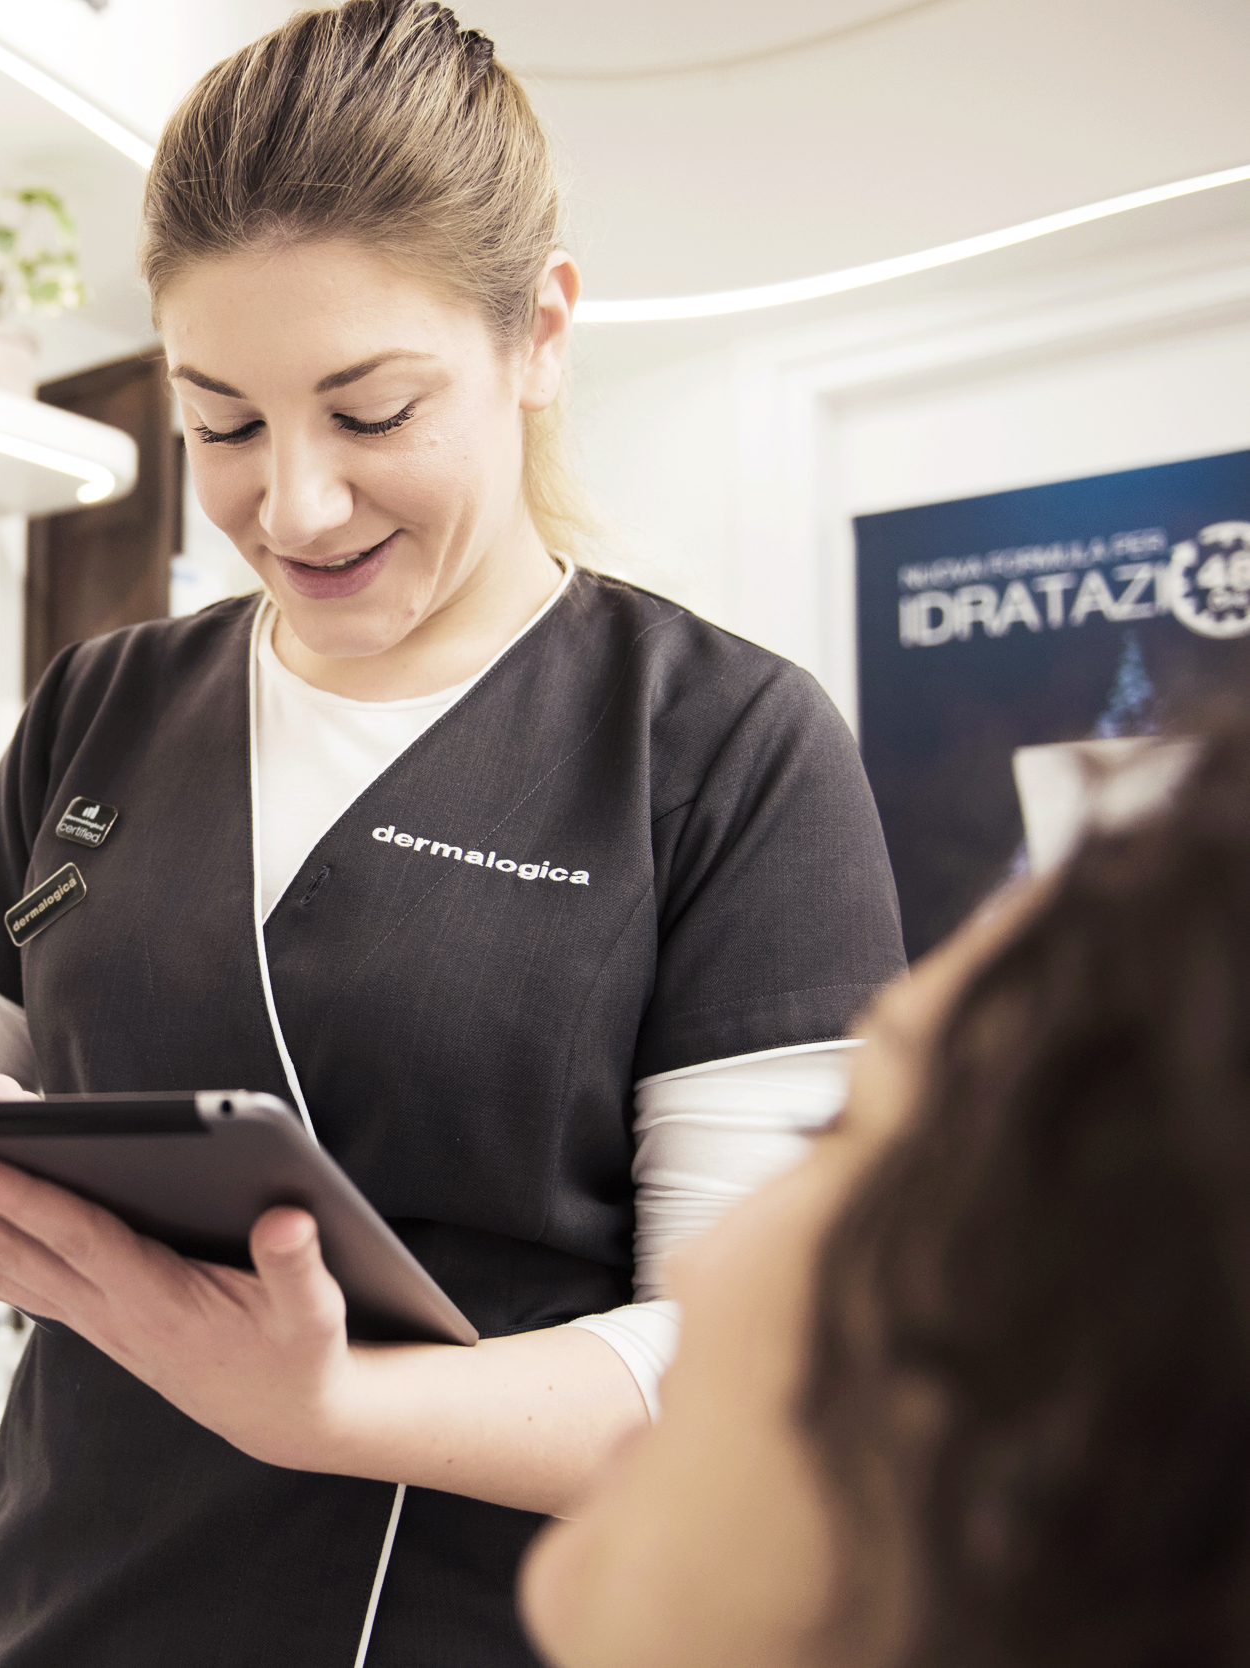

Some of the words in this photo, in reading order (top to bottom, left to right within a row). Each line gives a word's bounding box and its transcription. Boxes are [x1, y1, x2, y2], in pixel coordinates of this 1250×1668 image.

[59, 822, 101, 843] certified
[372, 825, 590, 886] dermalogica
[12, 876, 78, 932] dermalogica
